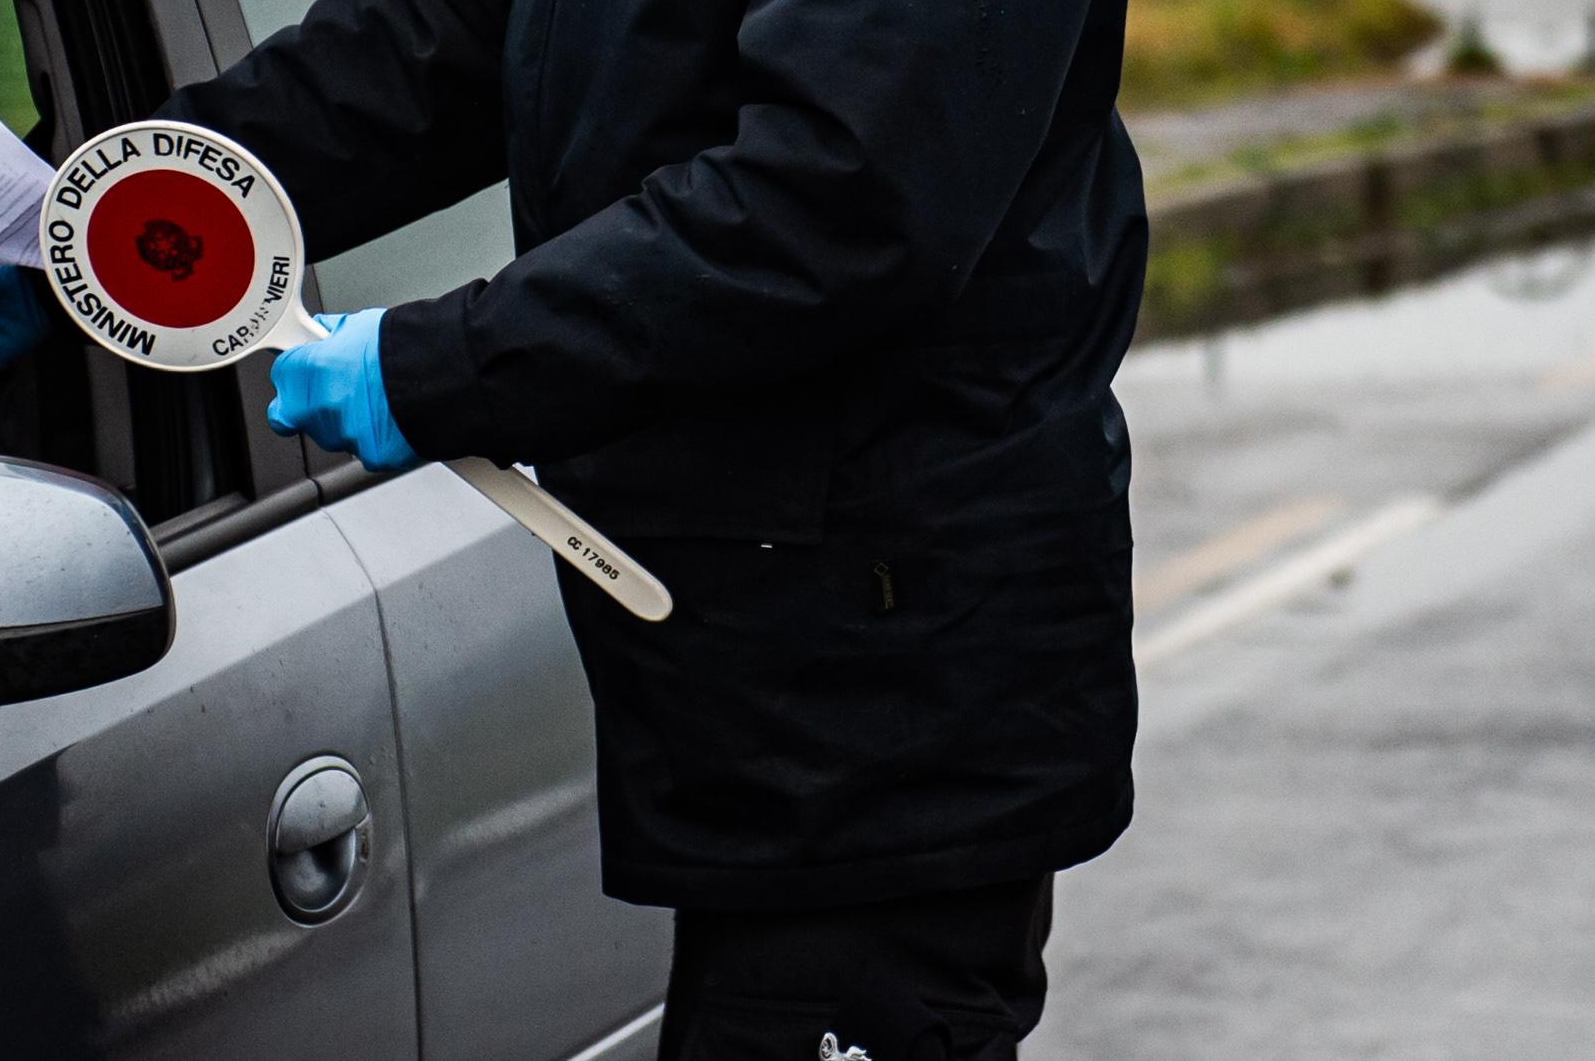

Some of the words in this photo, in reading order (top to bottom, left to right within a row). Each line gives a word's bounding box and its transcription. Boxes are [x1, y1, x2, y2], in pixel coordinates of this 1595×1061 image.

[56, 137, 141, 210] DELLA
[152, 132, 256, 198] DIFESA
[48, 219, 156, 356] MINISTERO
[567, 536, 582, 550] CC
[582, 547, 620, 580] 17985
